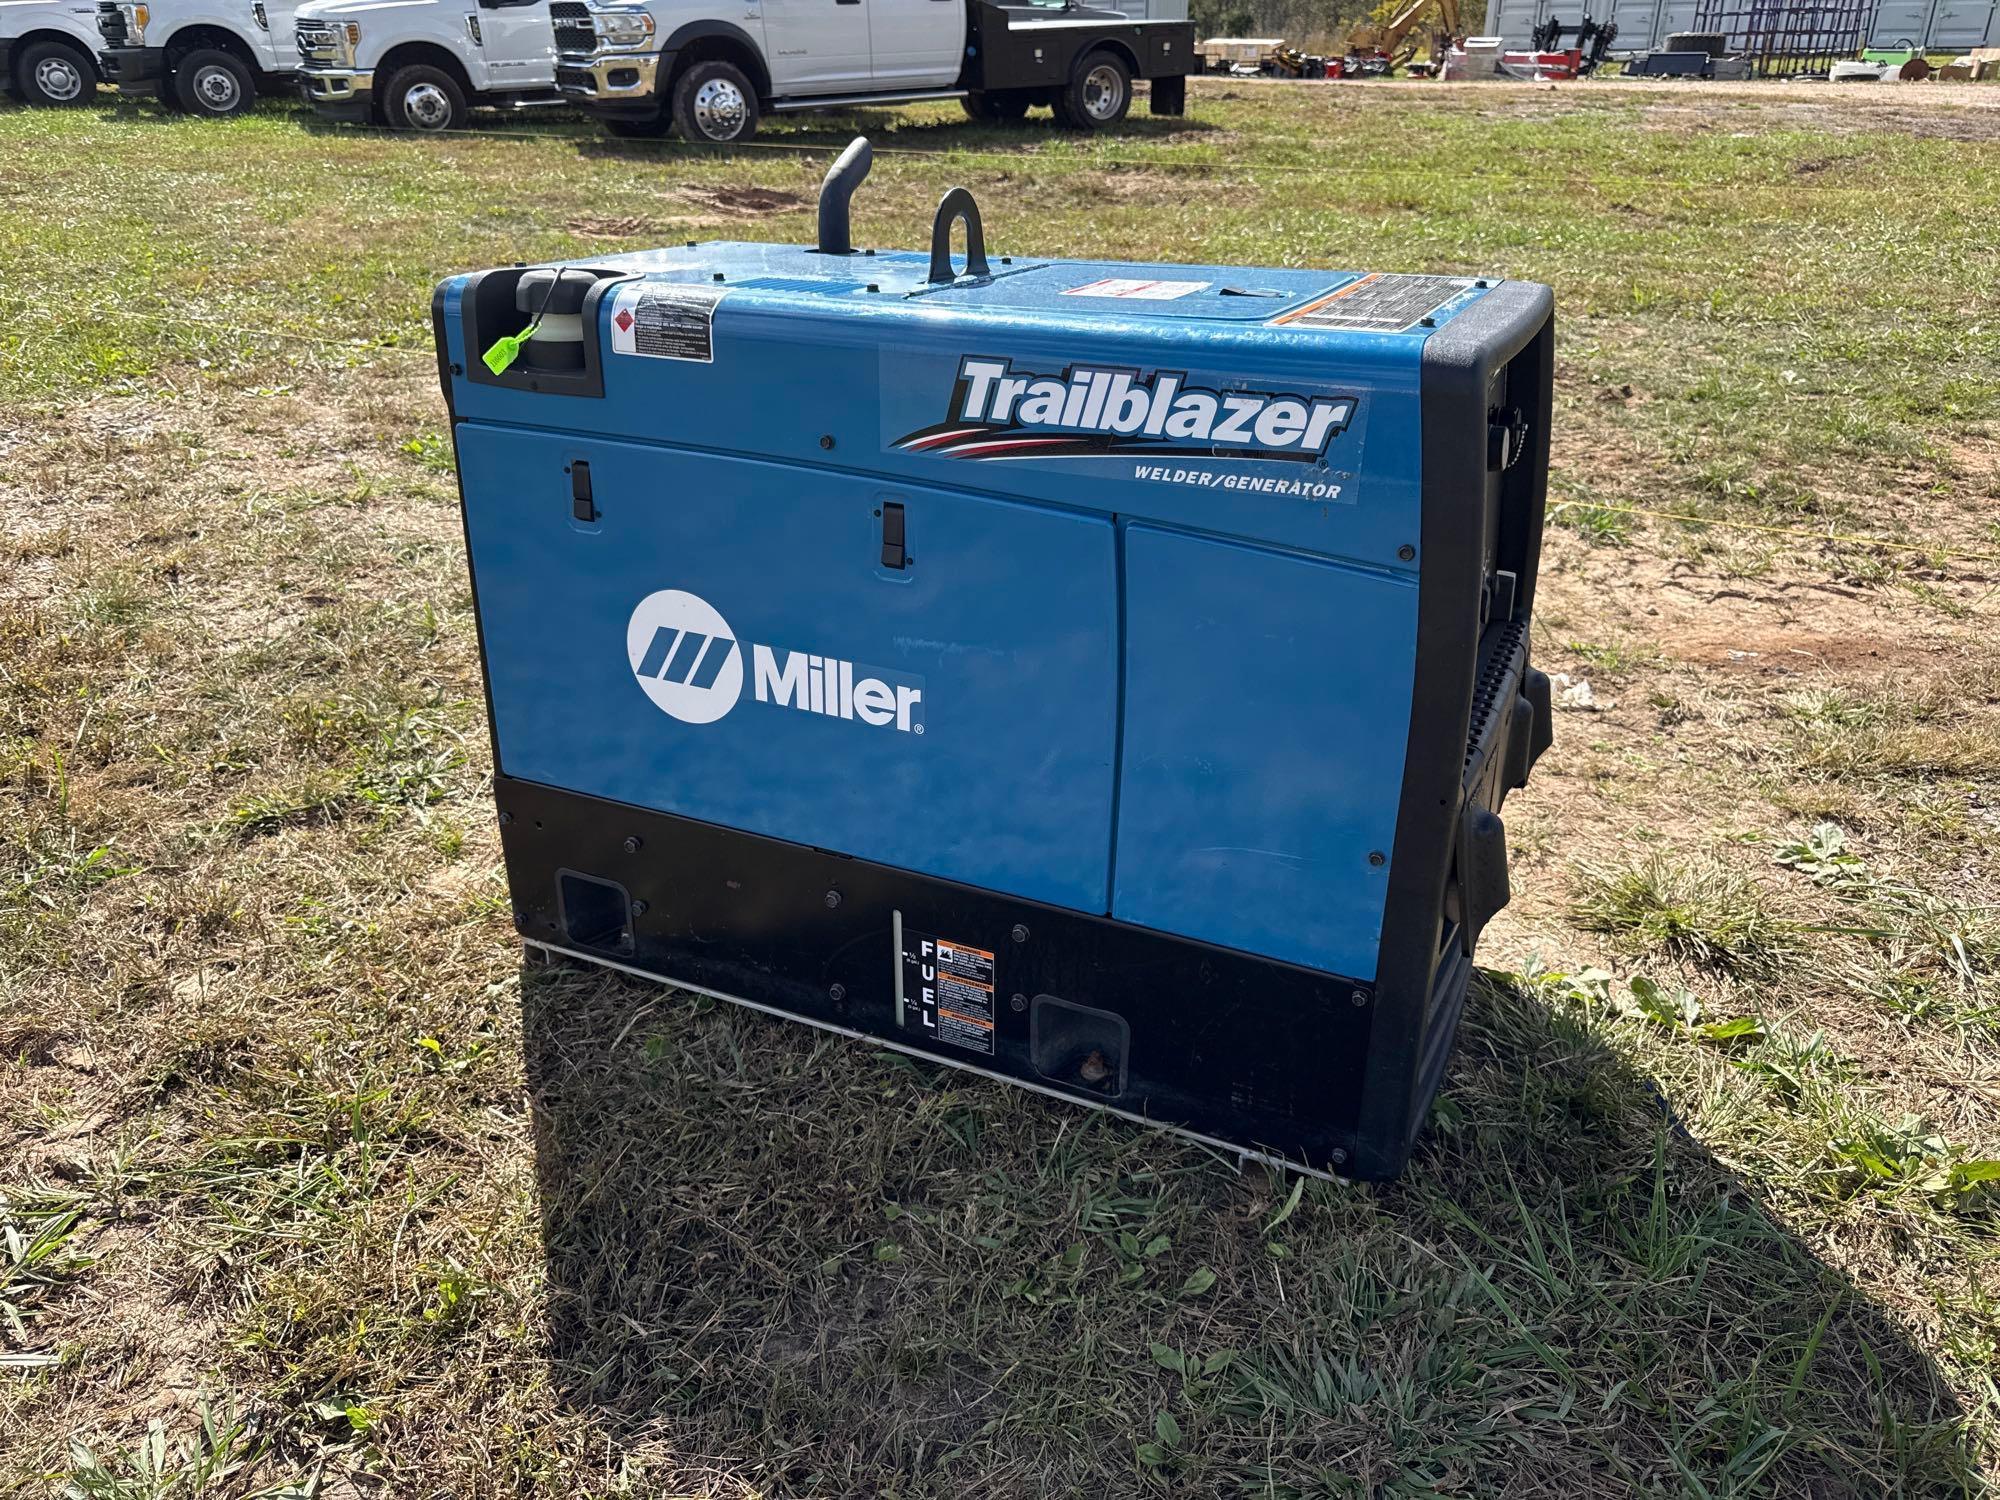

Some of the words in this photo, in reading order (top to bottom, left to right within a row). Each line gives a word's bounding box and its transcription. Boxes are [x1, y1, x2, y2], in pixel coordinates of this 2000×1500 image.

[963, 361, 1348, 451] Trailblazer
[1134, 465, 1342, 499] WELDER/GENERATOR
[753, 643, 921, 732] Miller
[921, 940, 936, 1028] FUEL
